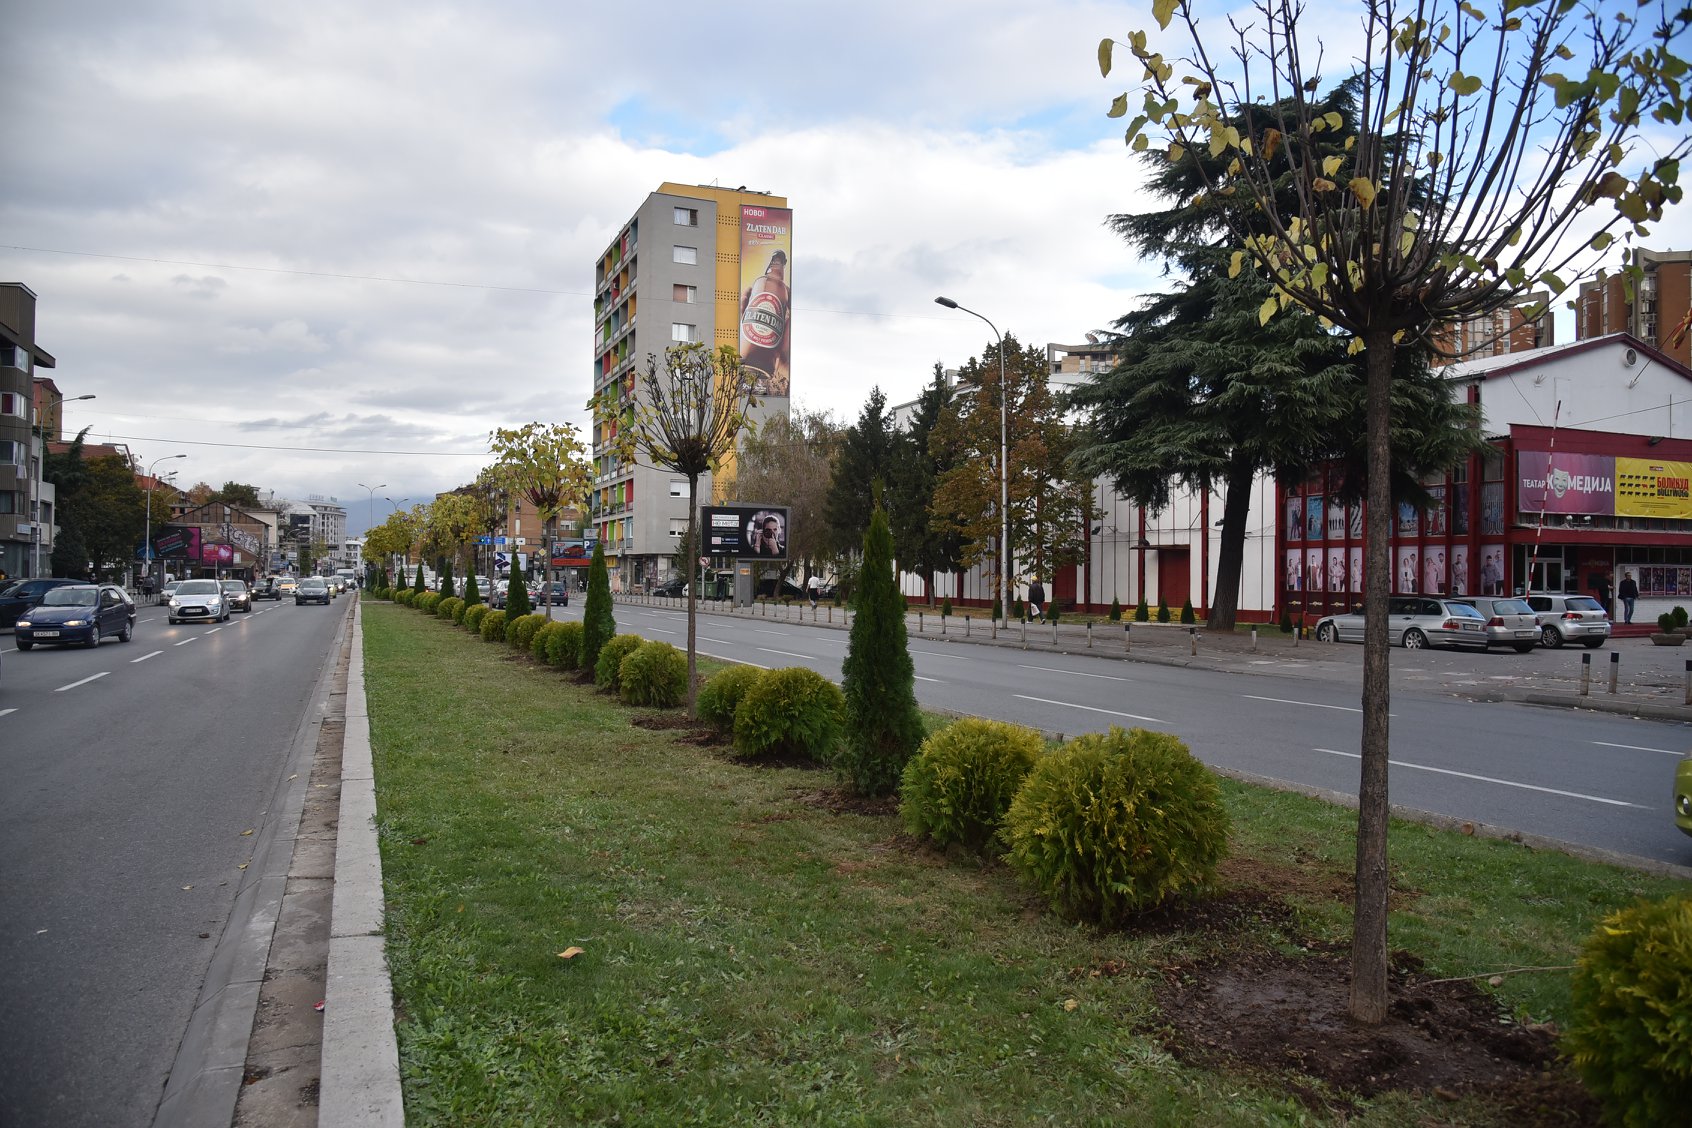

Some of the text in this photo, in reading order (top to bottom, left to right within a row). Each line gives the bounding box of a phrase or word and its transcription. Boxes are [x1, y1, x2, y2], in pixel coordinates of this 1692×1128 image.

[743, 208, 765, 217] НОВО!
[746, 222, 786, 235] ZLATEN DAB
[1523, 472, 1612, 494] ТЕАТАР КМЕДИЈА
